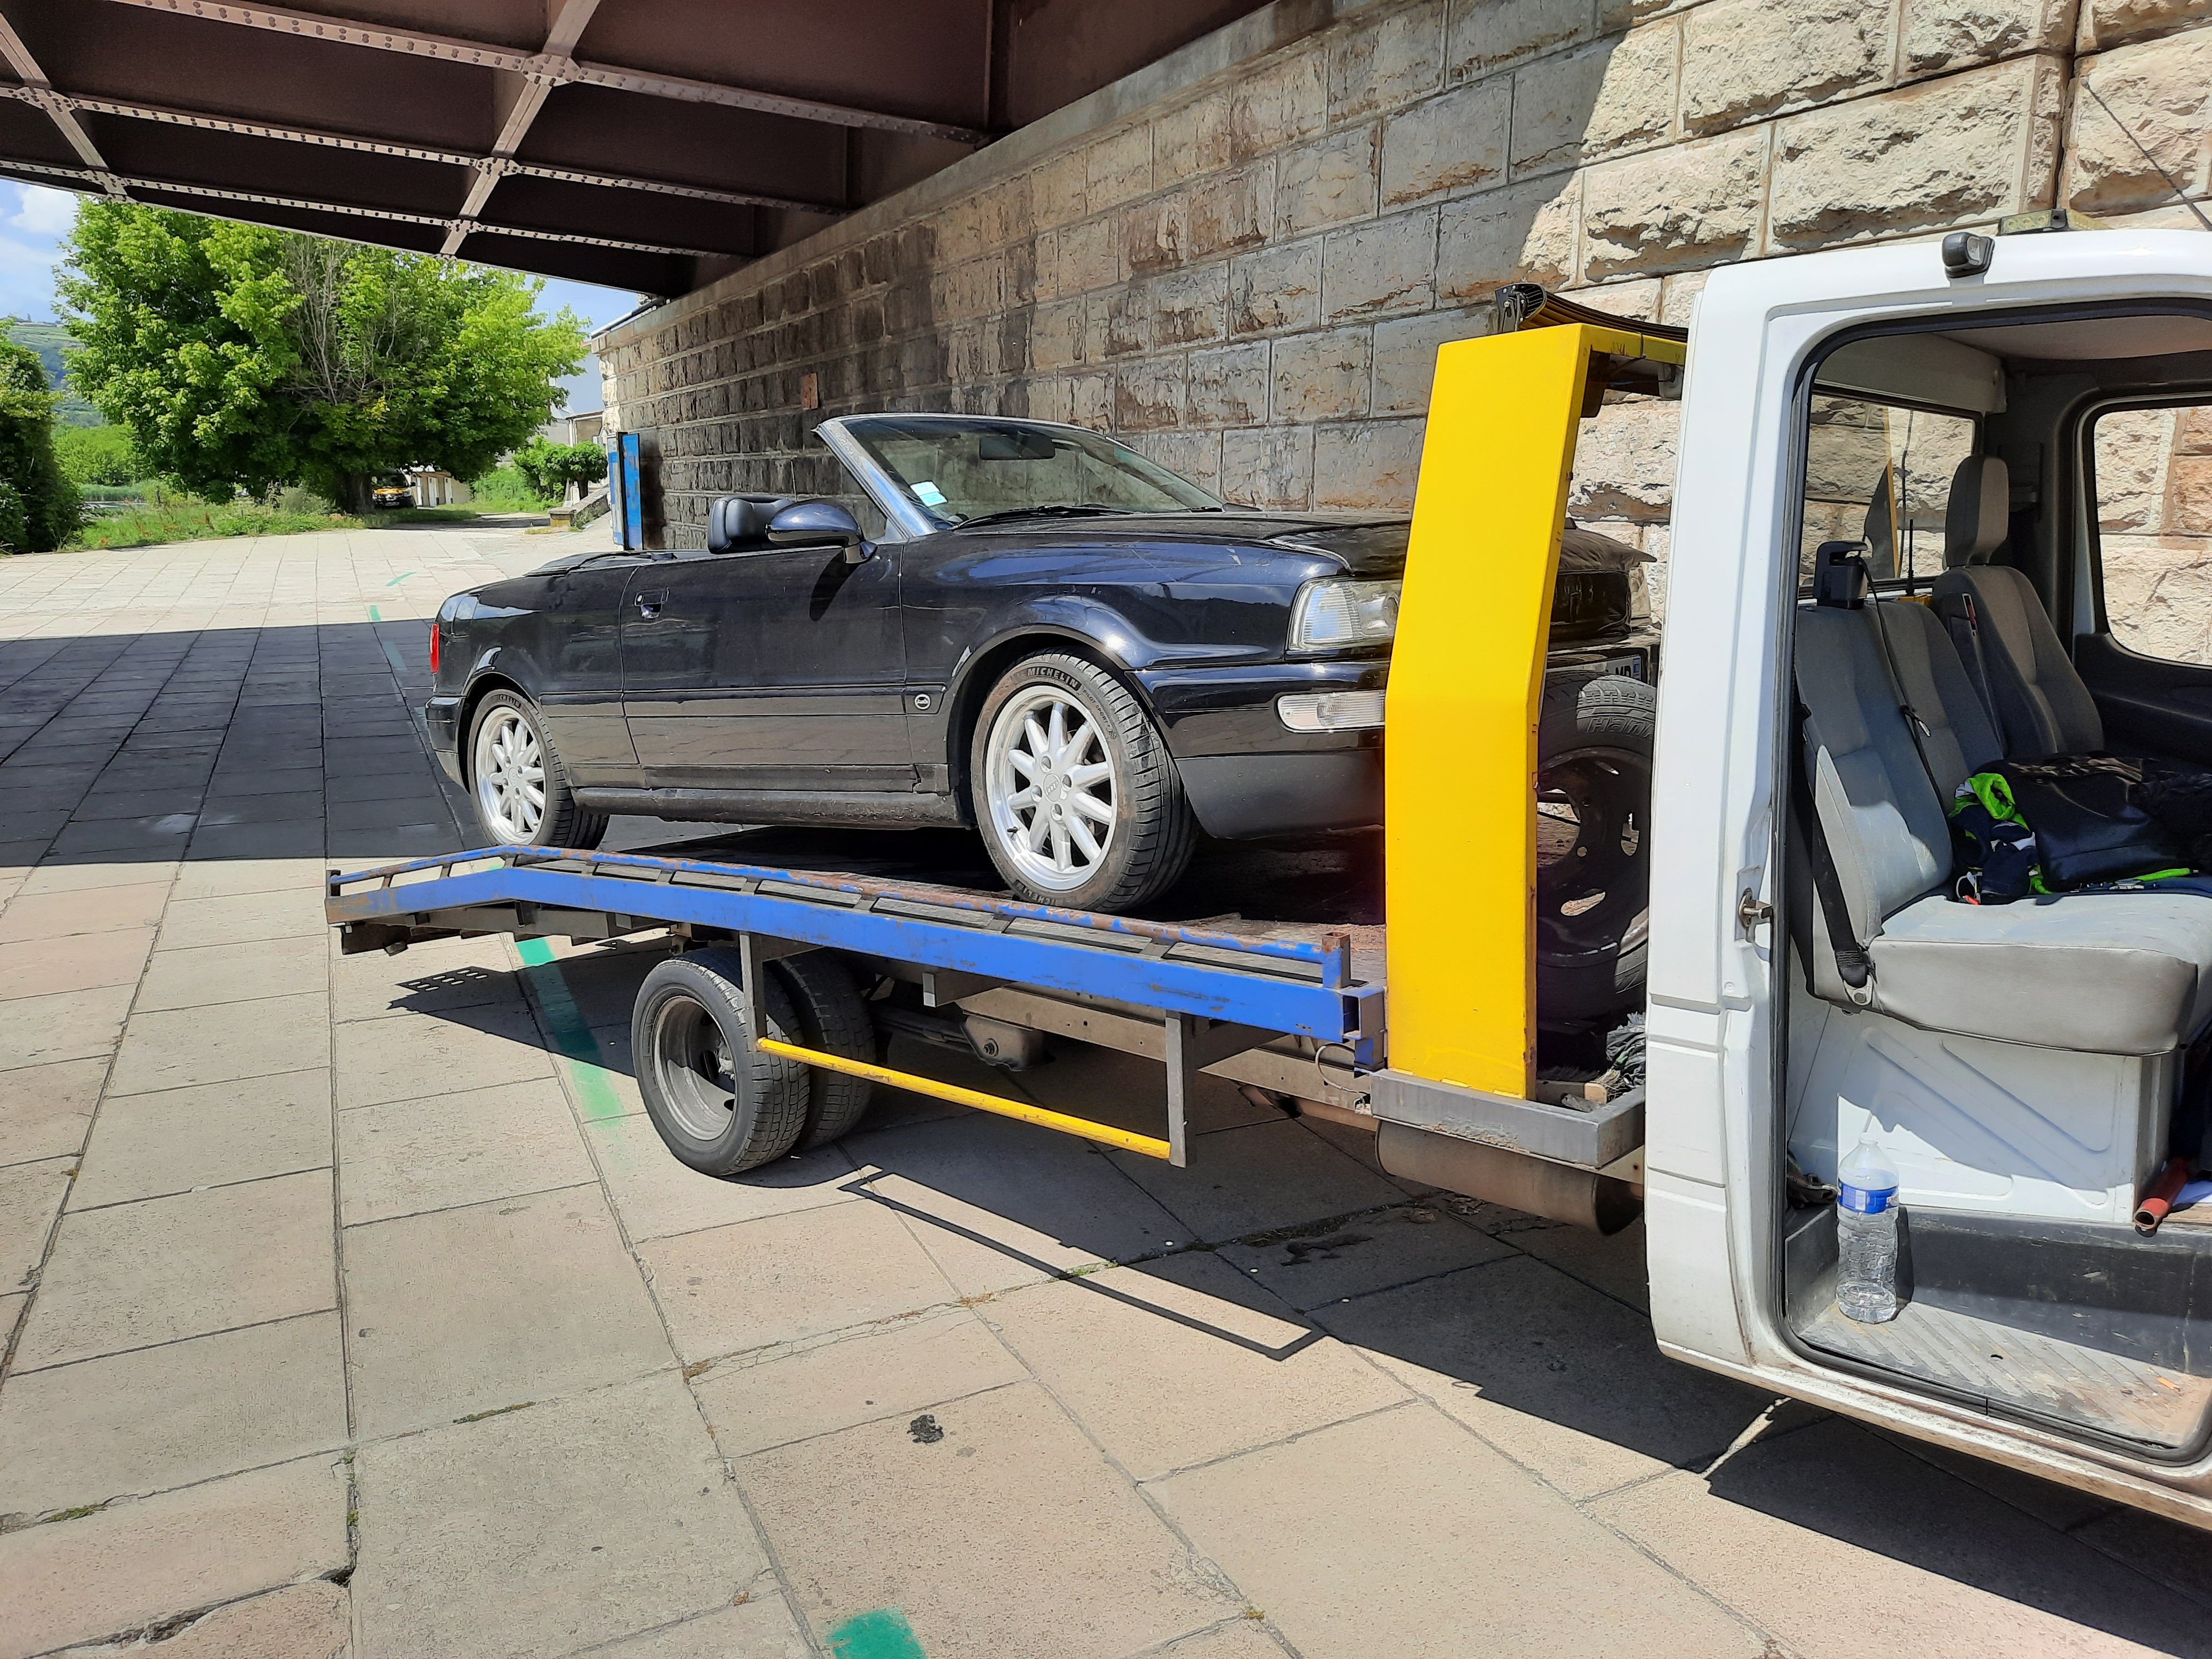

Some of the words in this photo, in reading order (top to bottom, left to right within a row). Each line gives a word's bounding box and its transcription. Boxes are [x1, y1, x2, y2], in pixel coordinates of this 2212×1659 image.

[1027, 667, 1078, 688] MICHELIN
[1083, 690, 1096, 703] PILOT
[1095, 705, 1109, 723] SPORT
